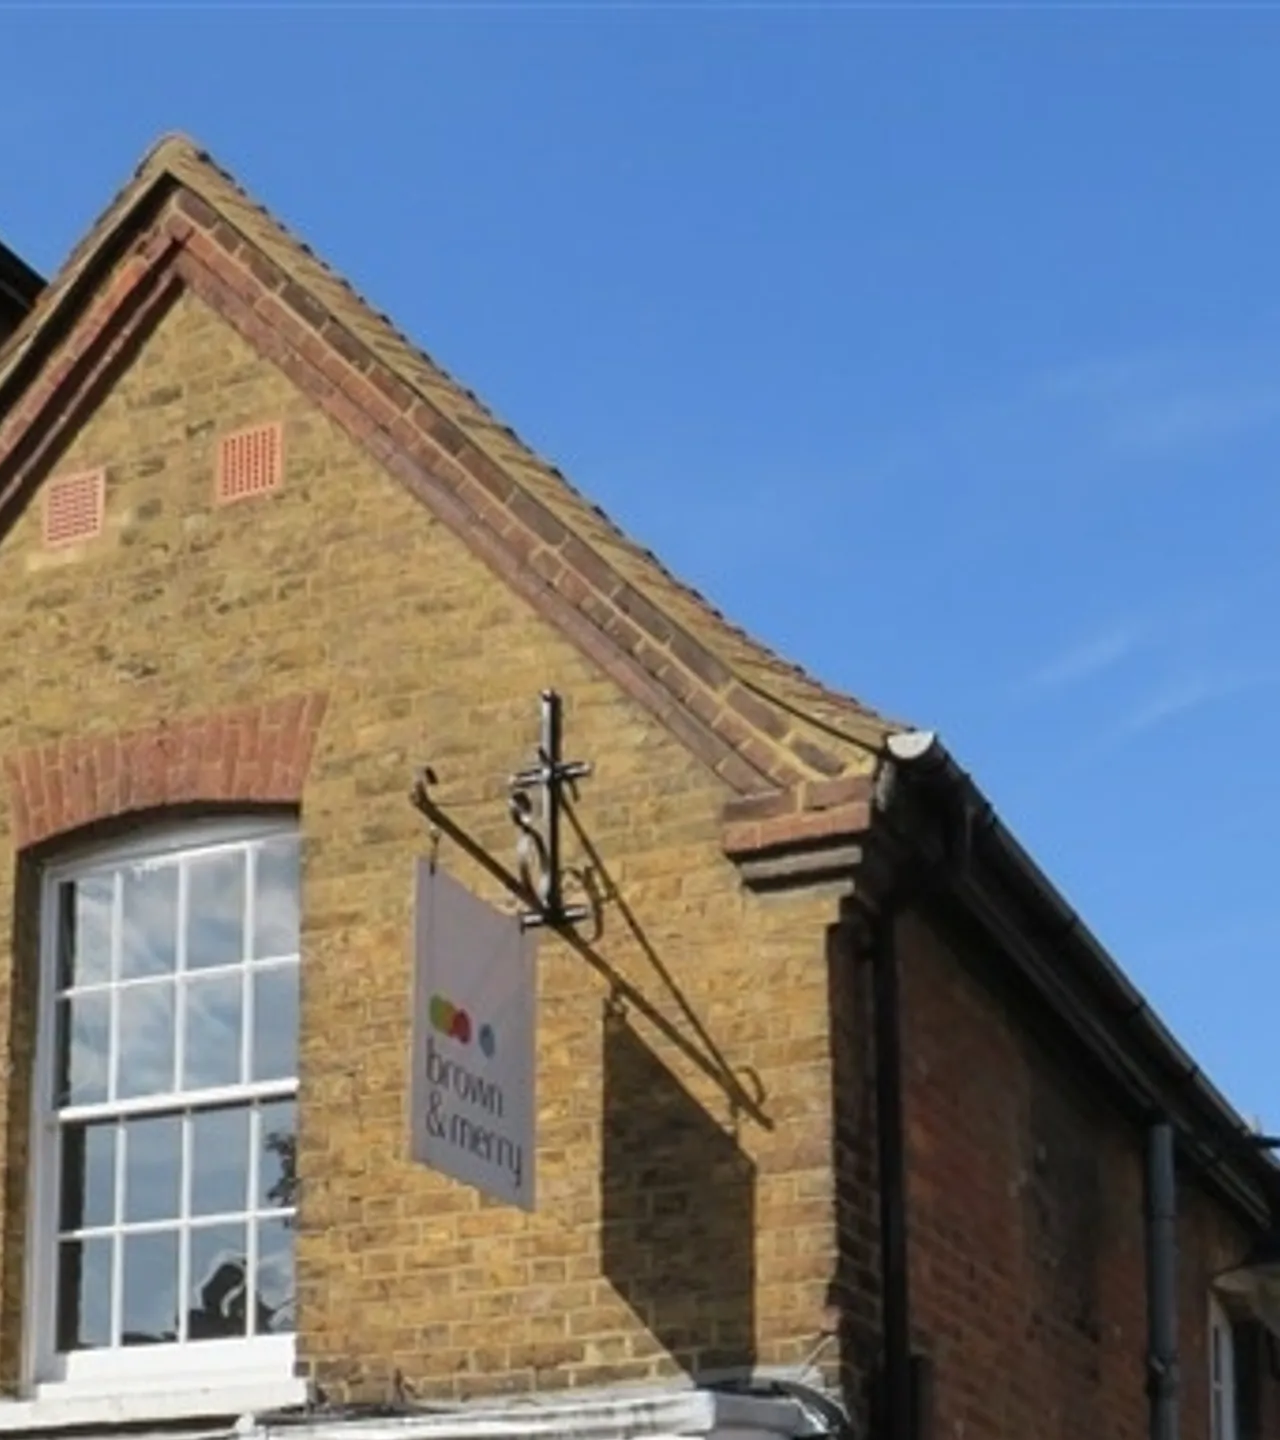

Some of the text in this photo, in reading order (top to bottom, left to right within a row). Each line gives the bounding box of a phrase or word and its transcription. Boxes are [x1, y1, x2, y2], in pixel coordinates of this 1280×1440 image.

[425, 1034, 504, 1118] brown
[425, 1088, 524, 1189] & merry
